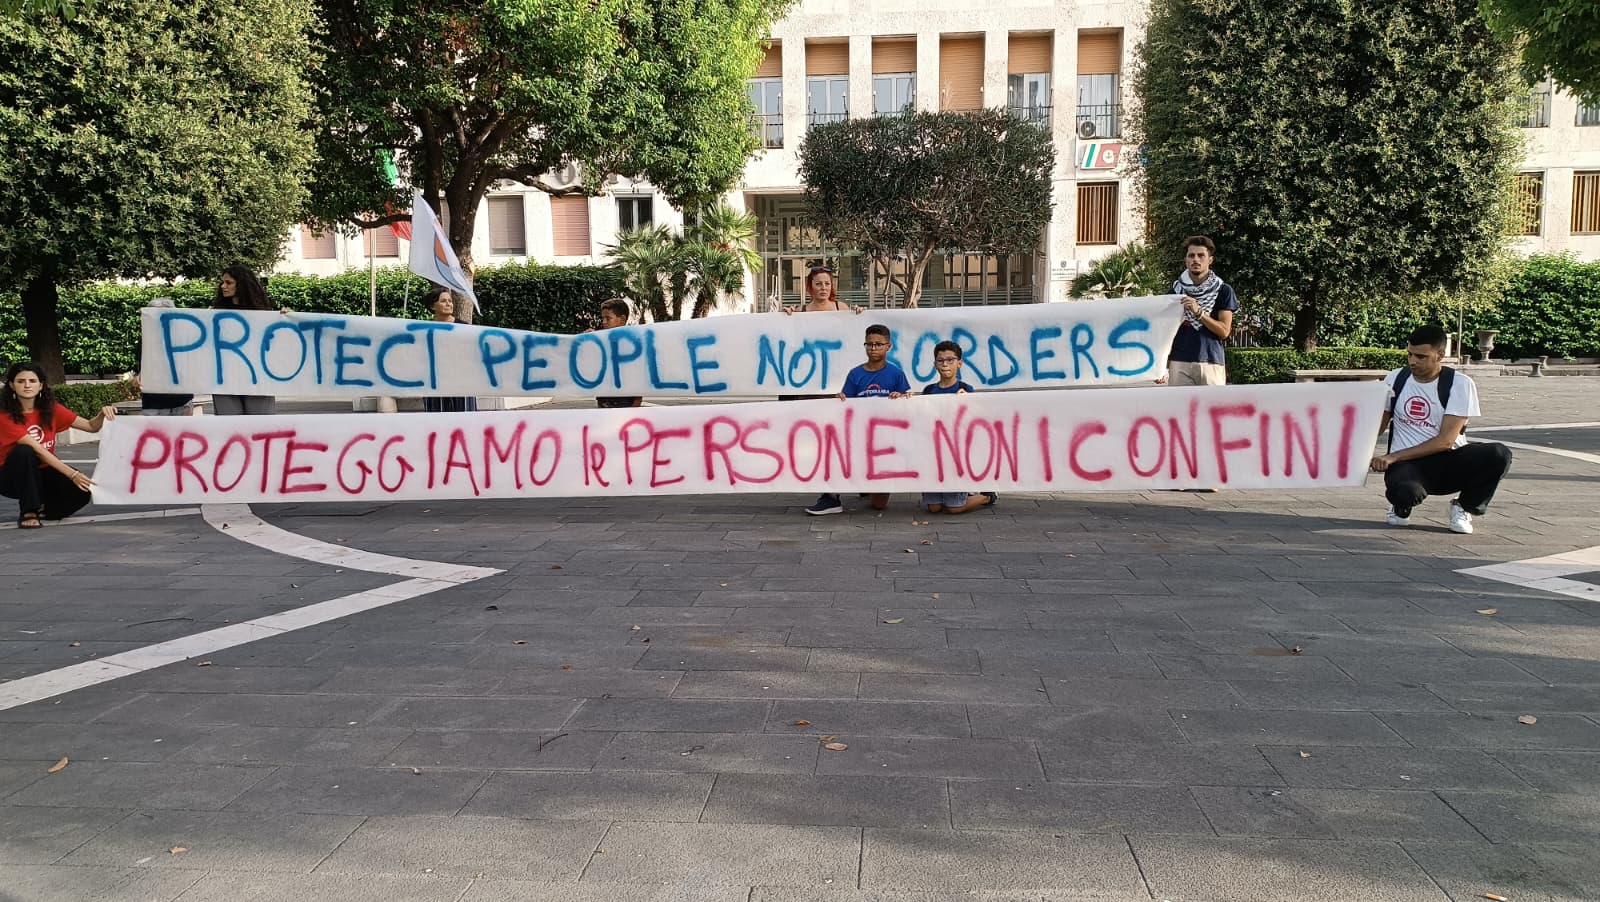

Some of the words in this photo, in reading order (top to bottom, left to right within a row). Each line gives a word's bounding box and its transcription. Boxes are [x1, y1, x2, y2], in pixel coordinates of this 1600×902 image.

[160, 312, 454, 389] PROTECT
[479, 329, 727, 393] PEOPLE
[757, 336, 842, 389] NOT
[129, 421, 561, 496] PROTEGGIAMO
[582, 425, 609, 487] le
[619, 408, 919, 488] PERSONE
[933, 406, 1020, 483] NON
[1038, 417, 1053, 482] I
[1069, 401, 1355, 483] CONFINI
